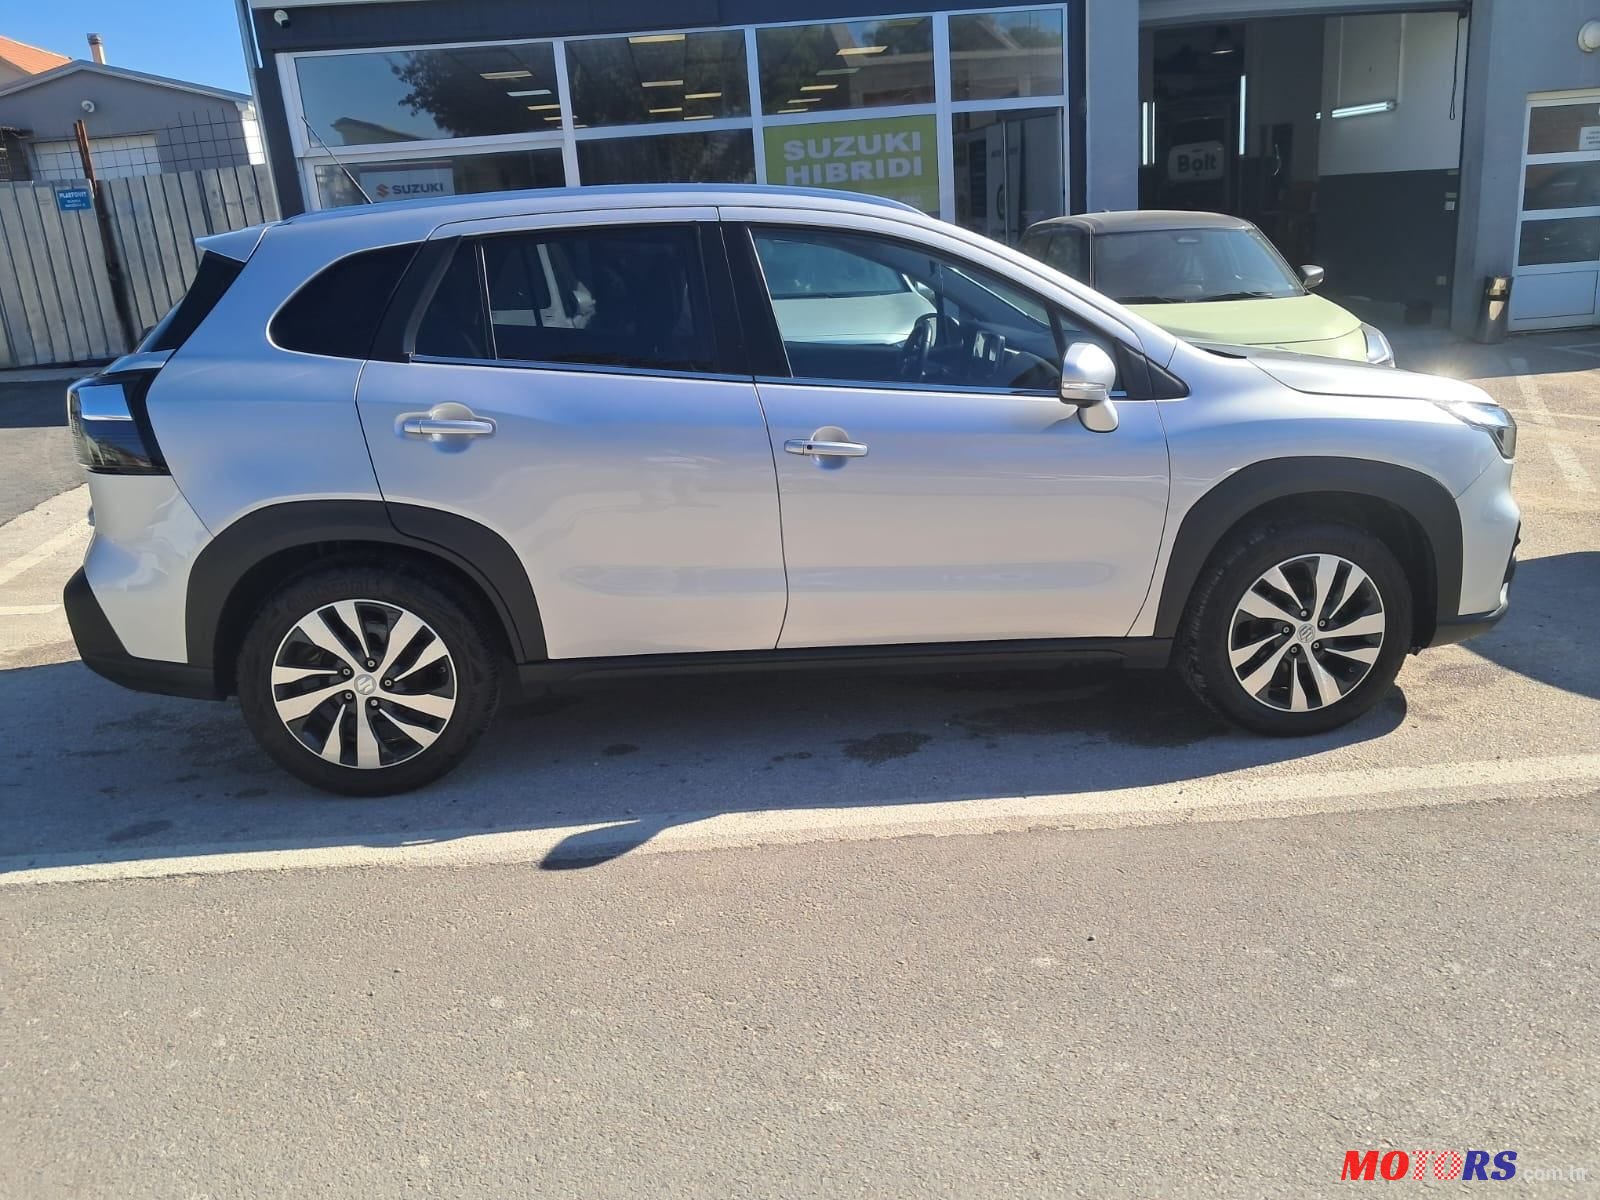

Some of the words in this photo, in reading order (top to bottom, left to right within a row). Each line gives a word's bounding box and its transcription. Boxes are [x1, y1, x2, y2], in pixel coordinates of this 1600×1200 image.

[783, 131, 921, 161] SUZUKI
[785, 156, 923, 185] HIBRIDI
[1177, 152, 1217, 173] Bolt
[391, 182, 444, 195] SUZUKI
